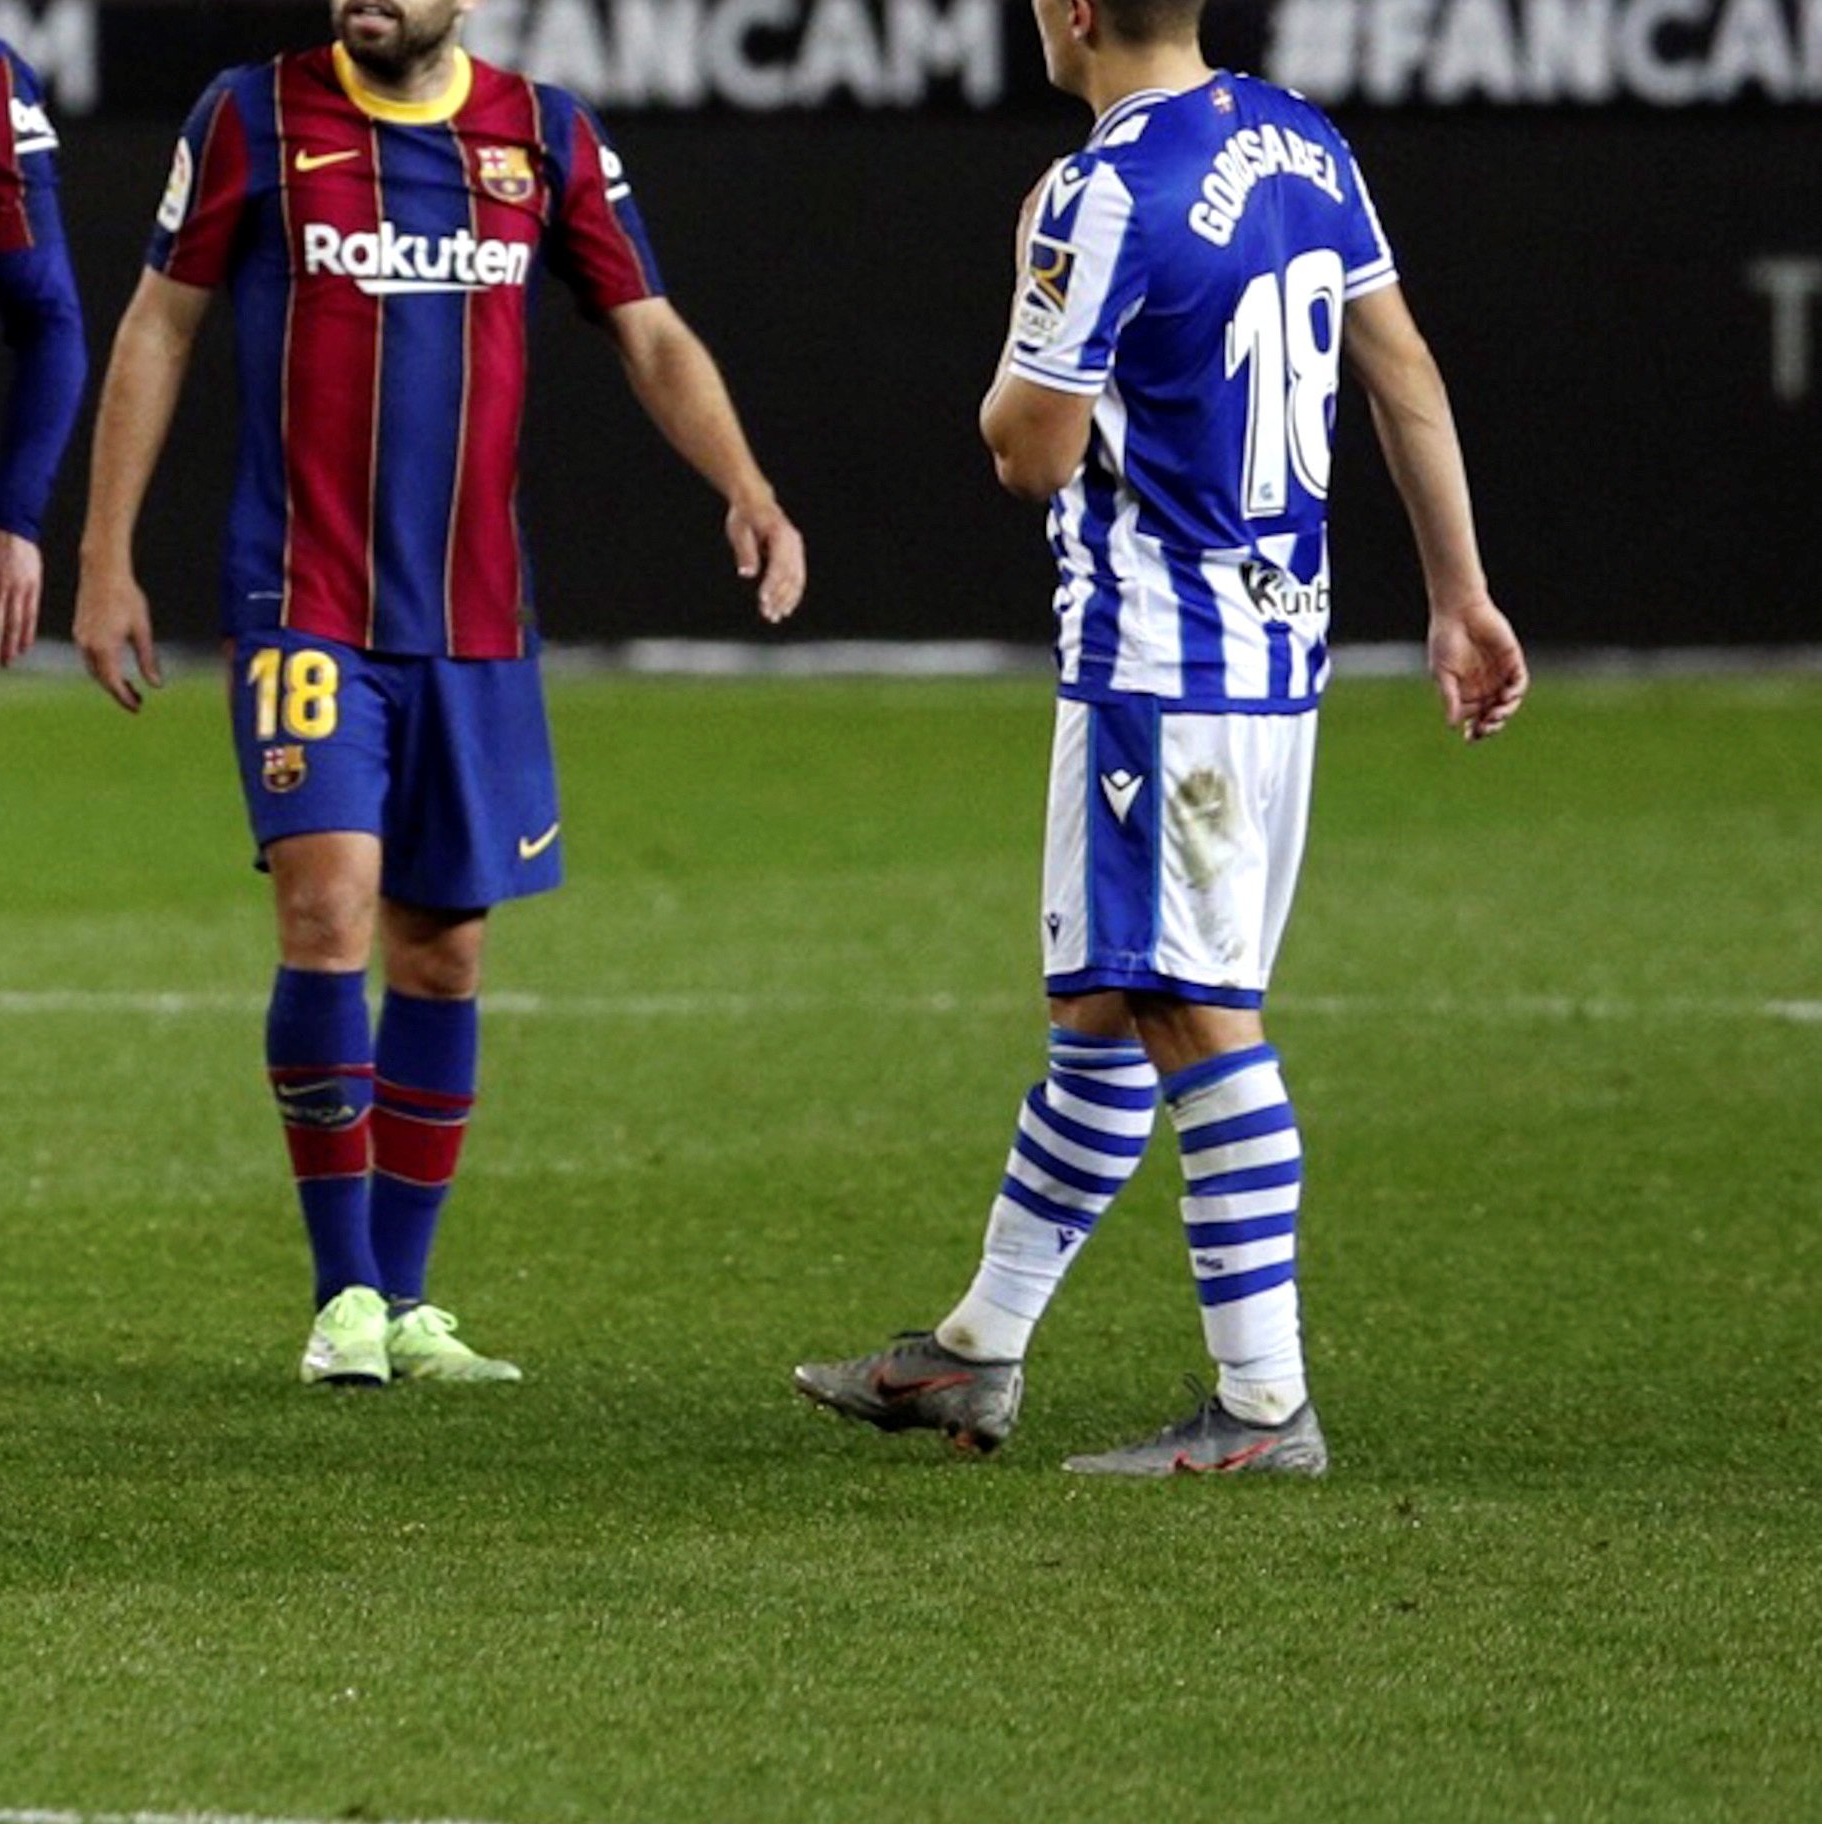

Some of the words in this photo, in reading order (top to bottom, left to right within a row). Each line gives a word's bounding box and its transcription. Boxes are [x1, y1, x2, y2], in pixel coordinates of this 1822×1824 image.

[1188, 123, 1344, 248] GOROSABEL
[303, 220, 531, 287] Rakuten
[1224, 247, 1344, 521] 18
[246, 646, 340, 742] 18
